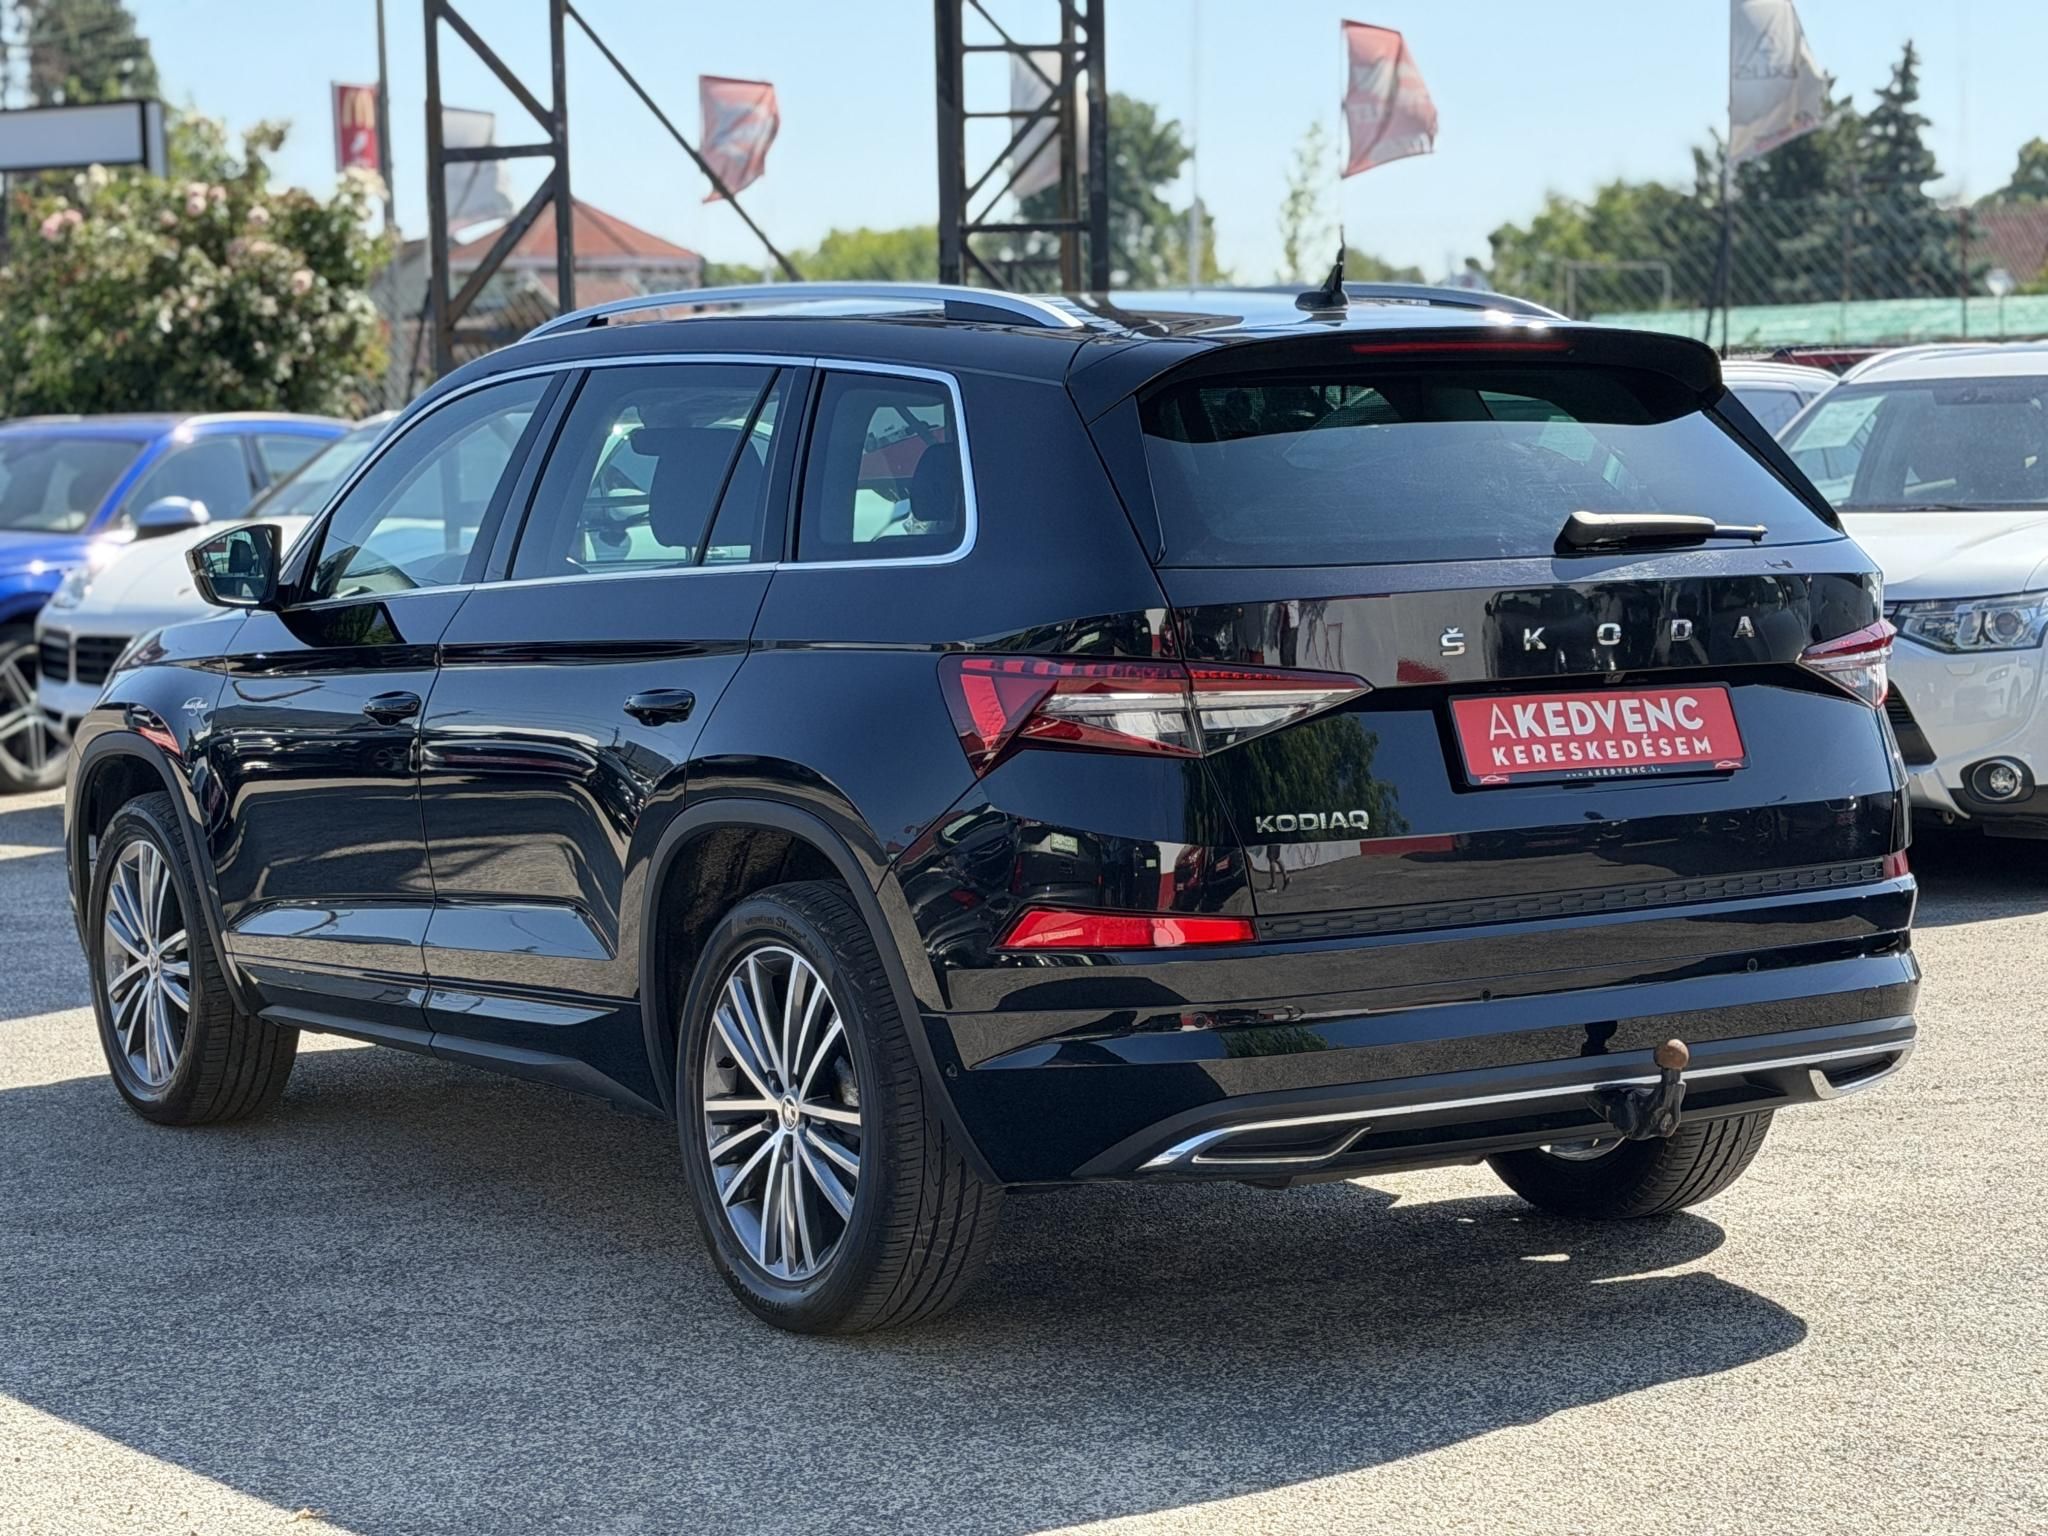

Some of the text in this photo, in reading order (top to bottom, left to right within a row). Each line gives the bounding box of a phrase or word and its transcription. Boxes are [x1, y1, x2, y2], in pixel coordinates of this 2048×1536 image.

[1440, 615, 1756, 657] ŠKODA
[1491, 733, 1713, 766] KERESKEDÉSEM
[1255, 809, 1370, 834] KODIAQ
